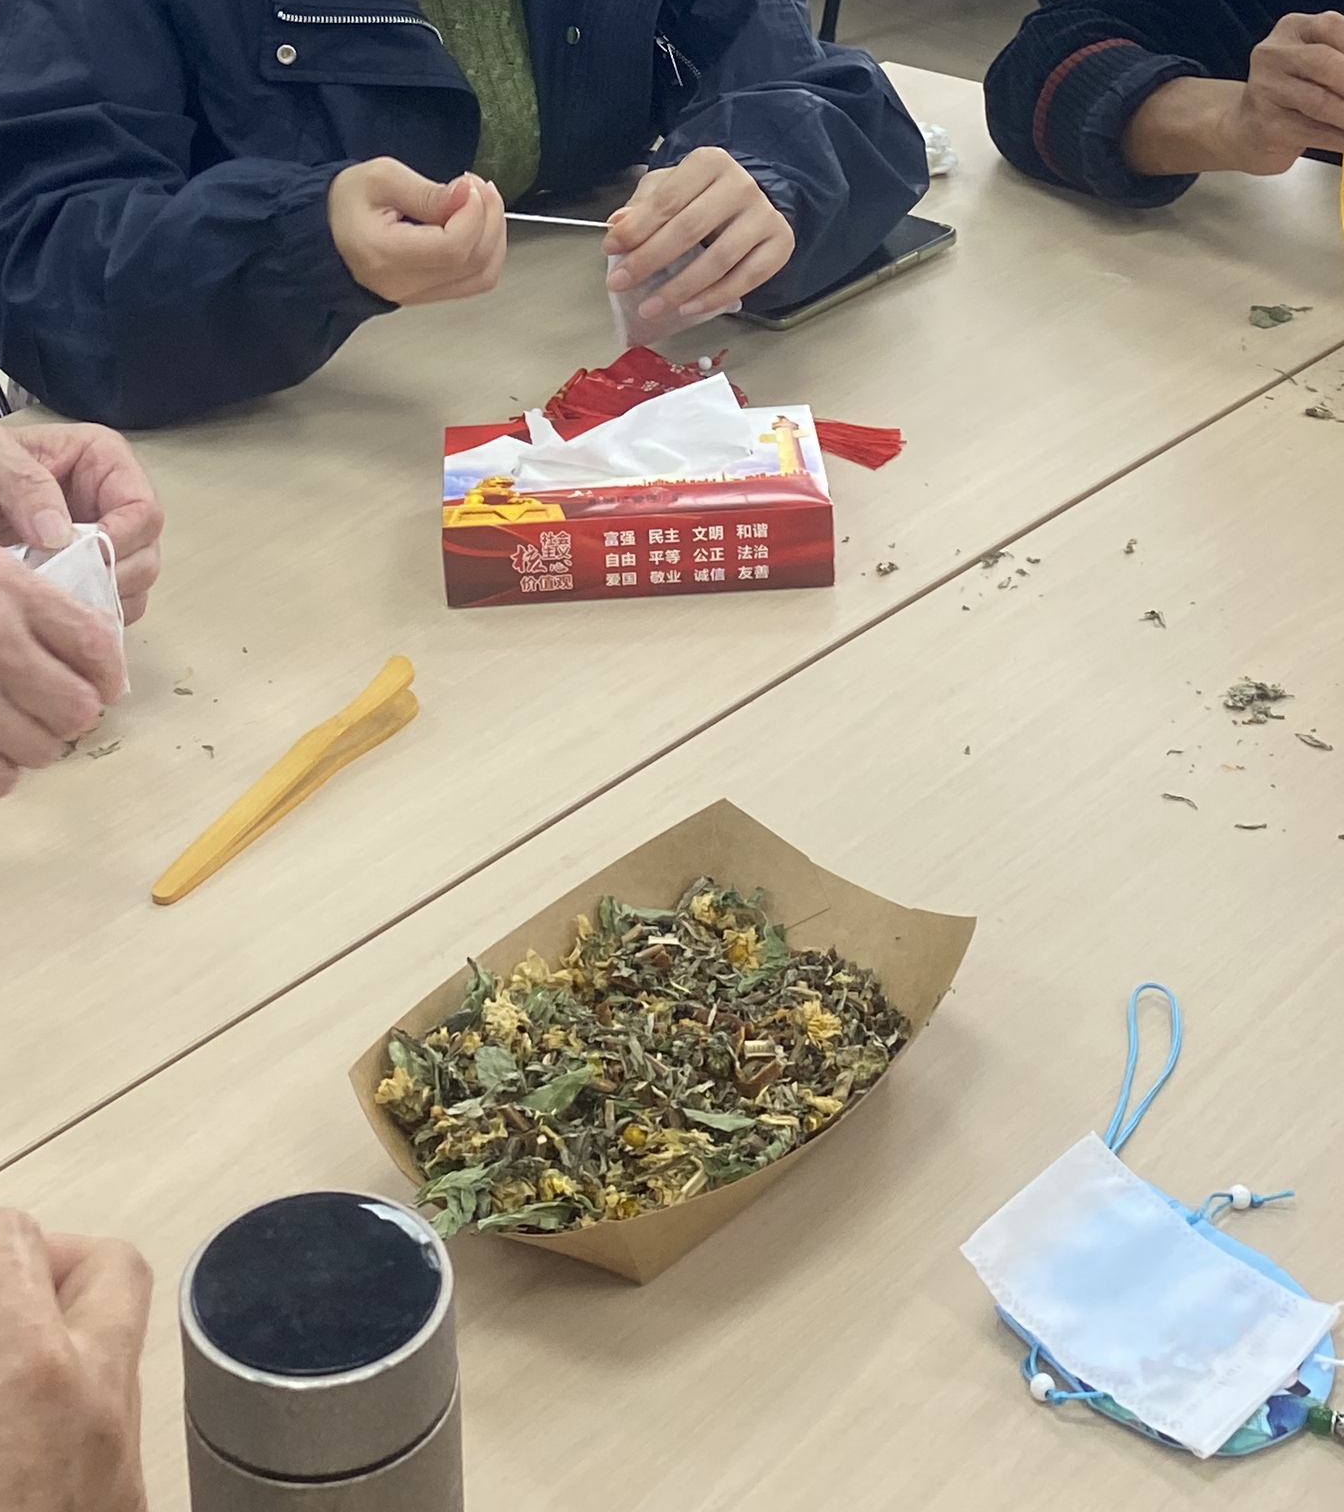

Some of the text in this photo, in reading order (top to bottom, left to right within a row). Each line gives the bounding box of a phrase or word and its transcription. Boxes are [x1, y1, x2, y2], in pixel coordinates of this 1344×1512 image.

[540, 530, 571, 546] 社会
[603, 523, 768, 546] 富强 民主 文明 和谐
[541, 545, 572, 560] 主义
[605, 544, 768, 568] 自由 平等 公正 法治
[520, 574, 574, 592] 价值观
[606, 565, 769, 586] 爱国 敬业 诚信 友善
